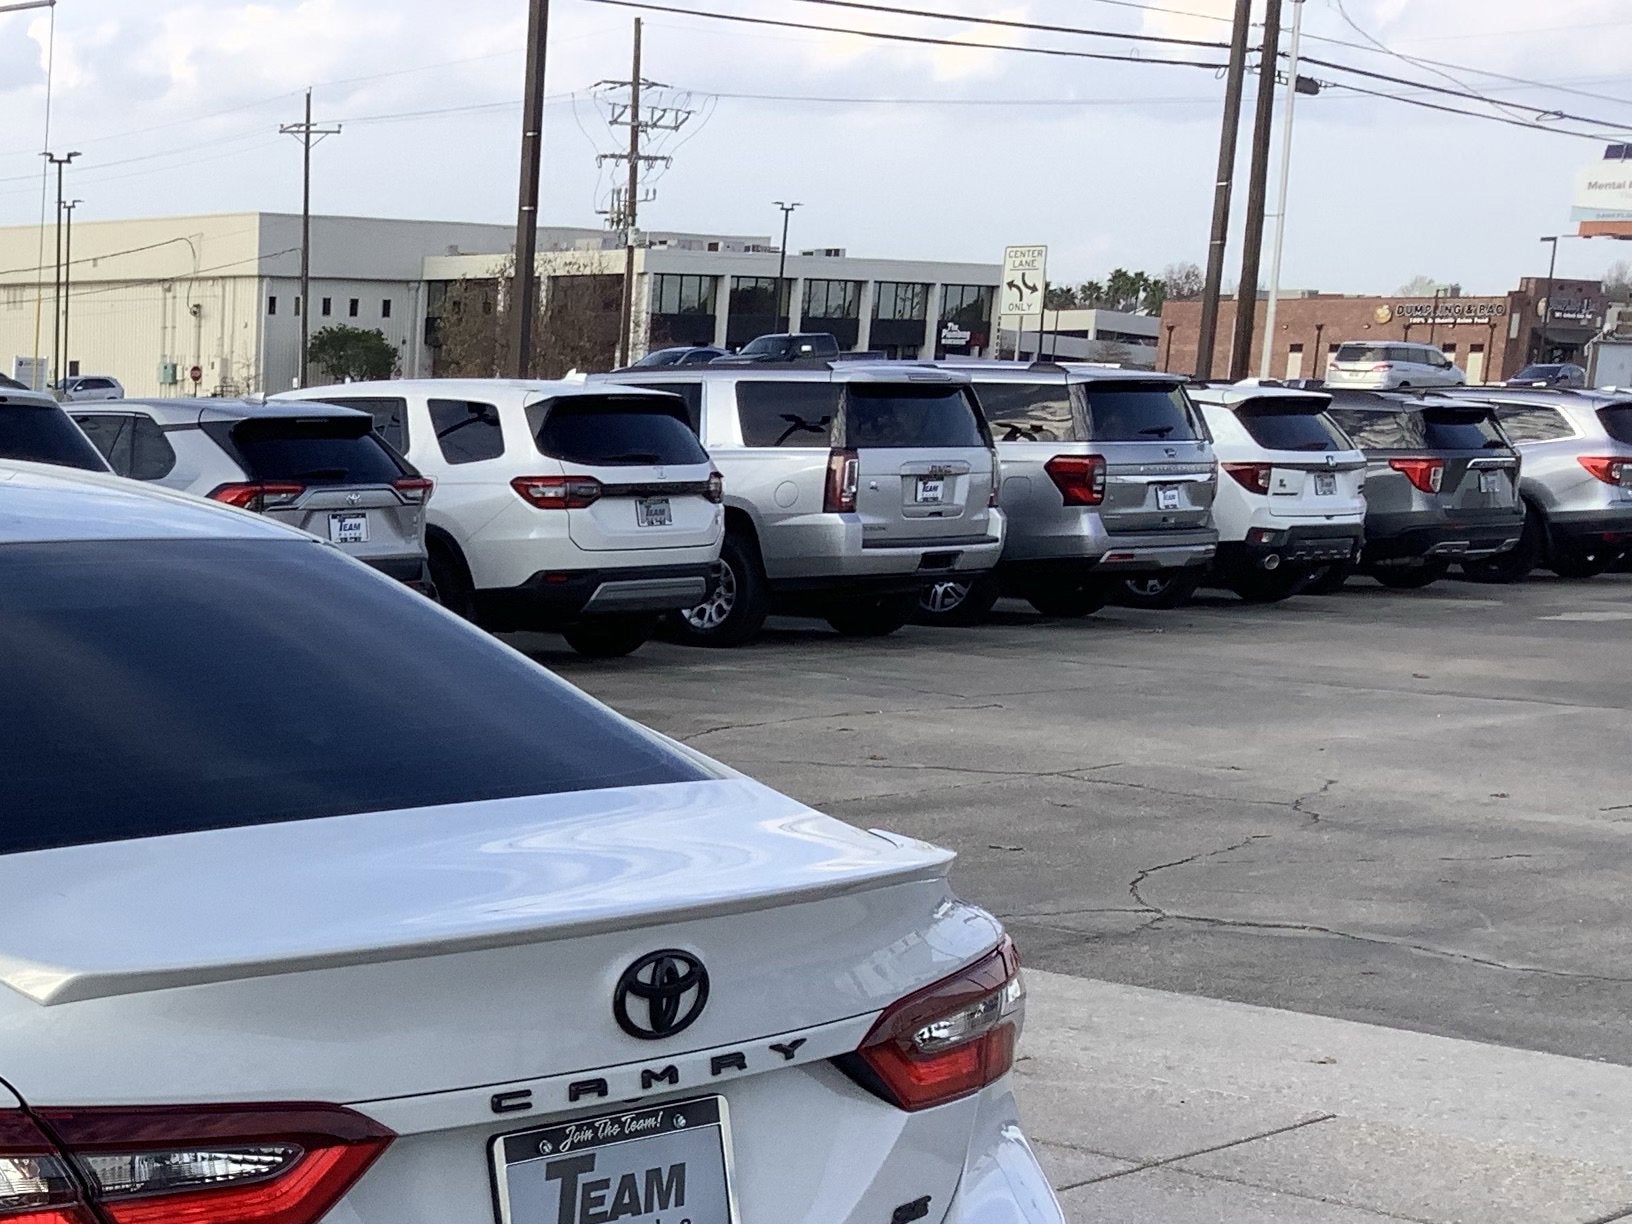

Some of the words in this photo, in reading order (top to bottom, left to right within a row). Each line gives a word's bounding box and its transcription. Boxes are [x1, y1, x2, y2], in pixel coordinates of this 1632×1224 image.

[1587, 181, 1626, 190] Mental
[1008, 249, 1044, 259] CENTER
[1012, 260, 1038, 268] LANE
[1008, 303, 1033, 312] ONLY
[1396, 304, 1462, 316] DUMPING
[1464, 304, 1475, 316] &
[1477, 304, 1506, 316] BAO
[338, 516, 361, 532] TEAM
[491, 1038, 807, 1113] CAMRY
[559, 1125, 594, 1152] Join
[594, 1119, 621, 1140] The
[621, 1111, 664, 1135] Team!
